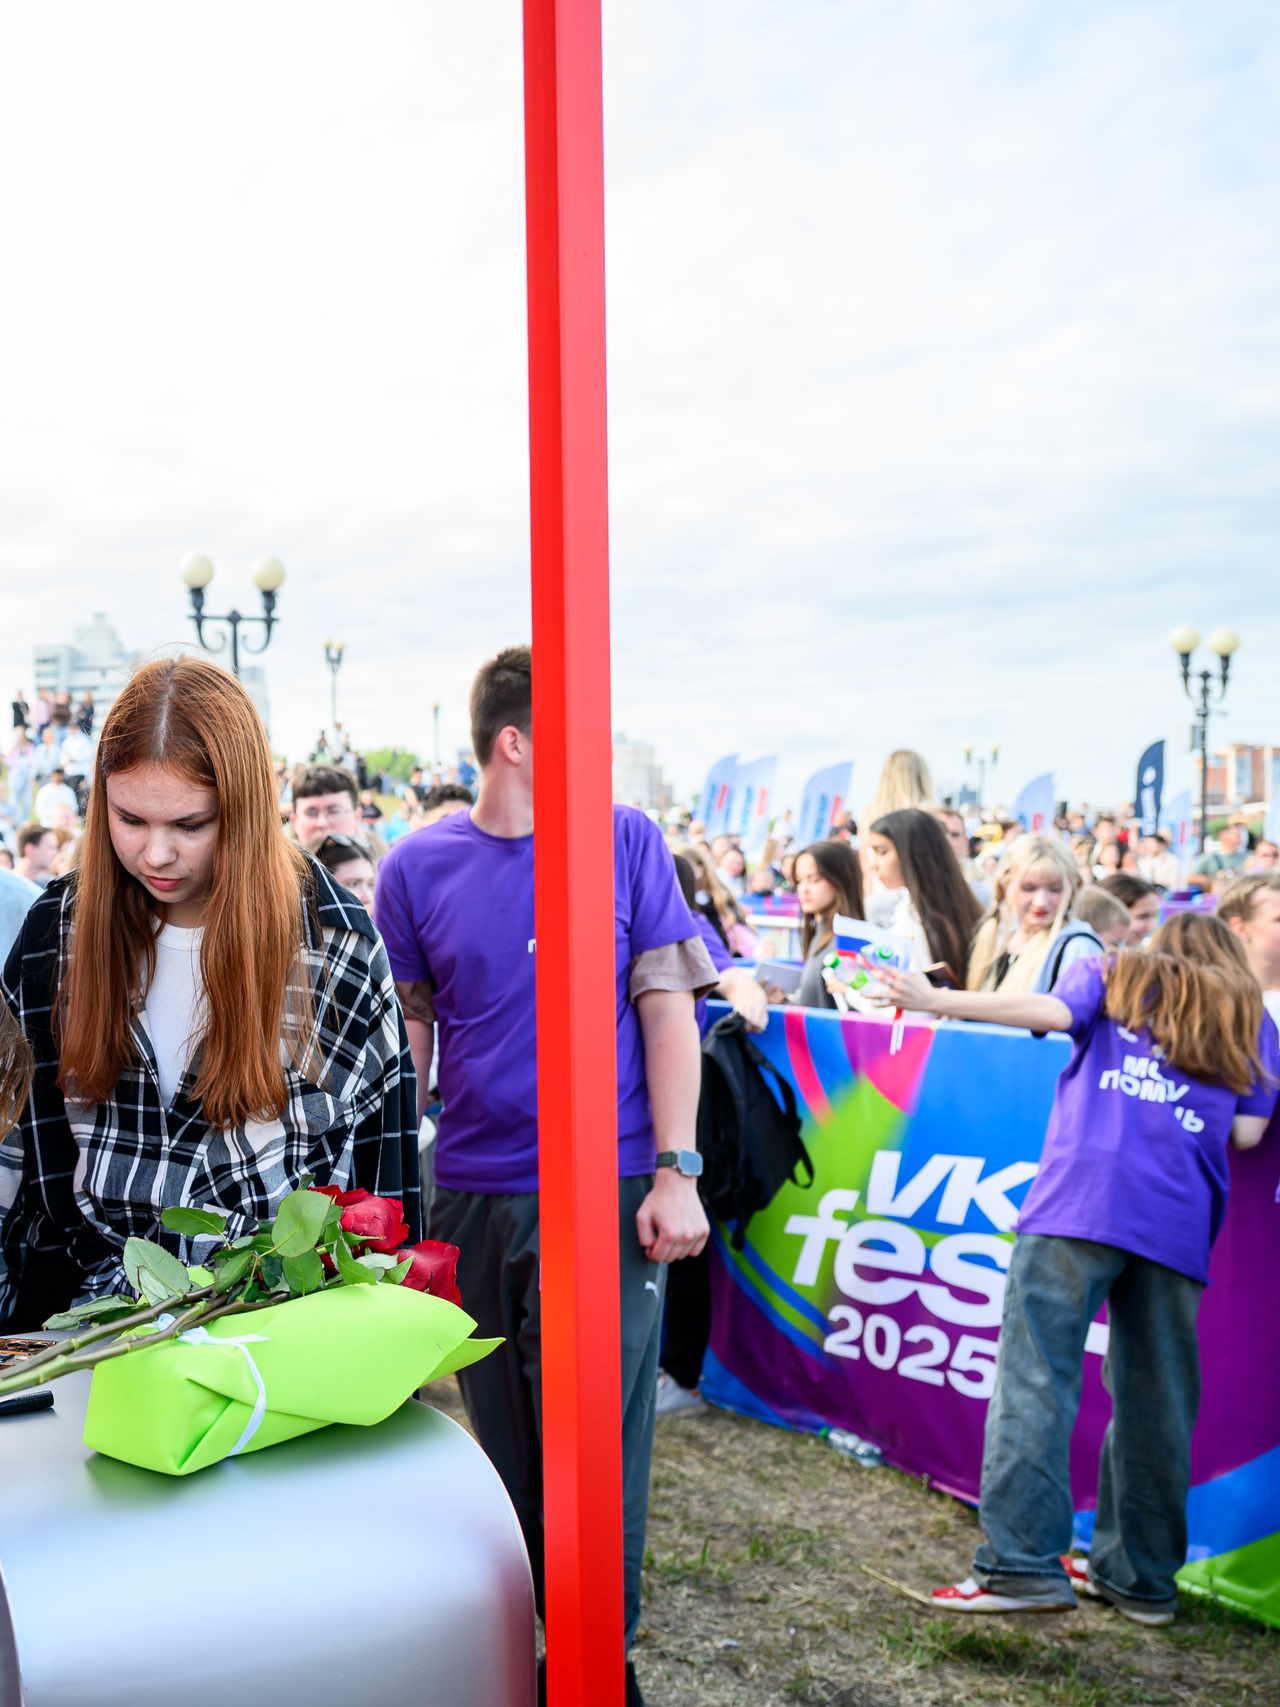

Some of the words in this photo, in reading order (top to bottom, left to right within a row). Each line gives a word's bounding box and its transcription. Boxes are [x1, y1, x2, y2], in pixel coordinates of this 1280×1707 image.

[866, 1150, 1041, 1234] VK
[784, 1188, 1016, 1328] fes
[823, 1304, 1000, 1399] 2025
